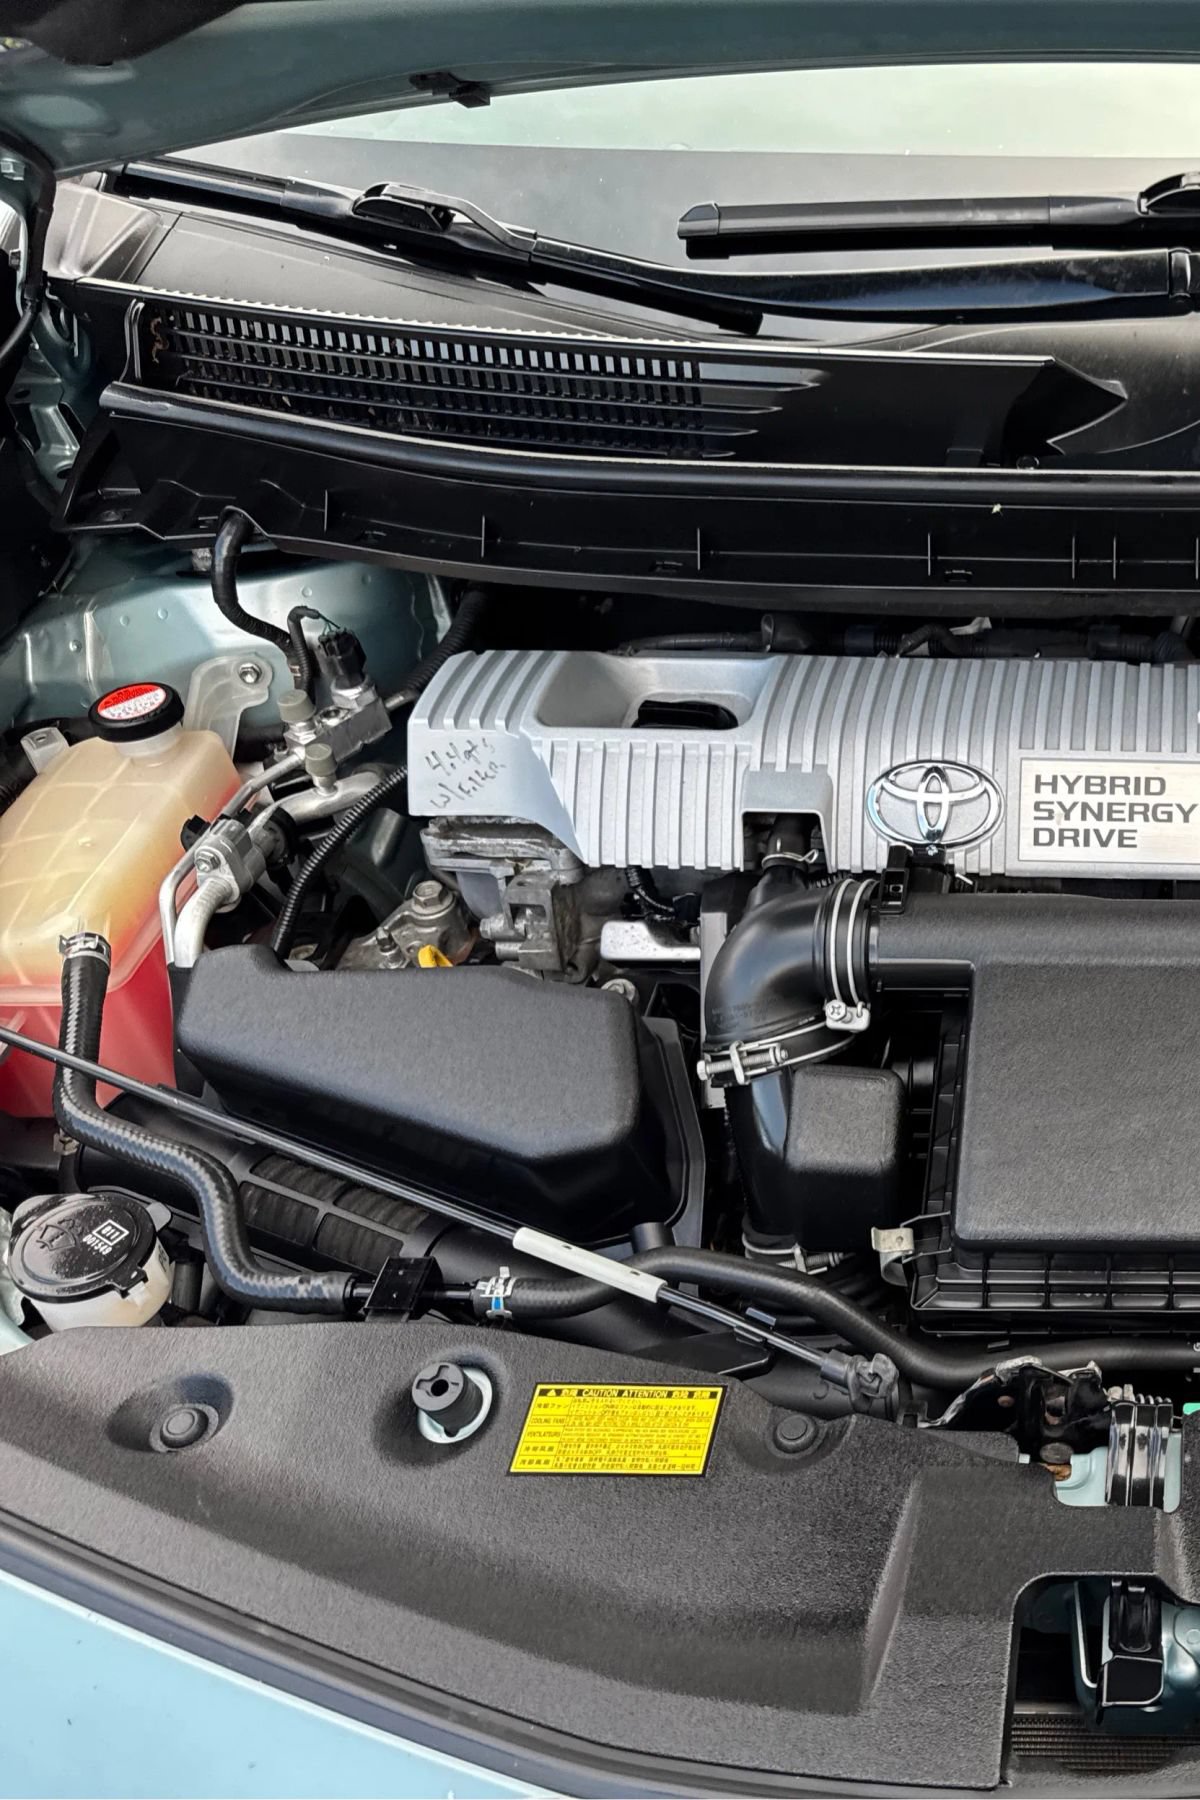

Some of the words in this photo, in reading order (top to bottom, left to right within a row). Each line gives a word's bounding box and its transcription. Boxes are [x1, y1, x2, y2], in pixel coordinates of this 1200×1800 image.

[1034, 774, 1167, 797] HYBRID
[1033, 800, 1199, 823] SYNERGY
[1033, 827, 1138, 849] DRIVE
[582, 1389, 618, 1398] CAUTION
[621, 1390, 668, 1398] ATTENTION
